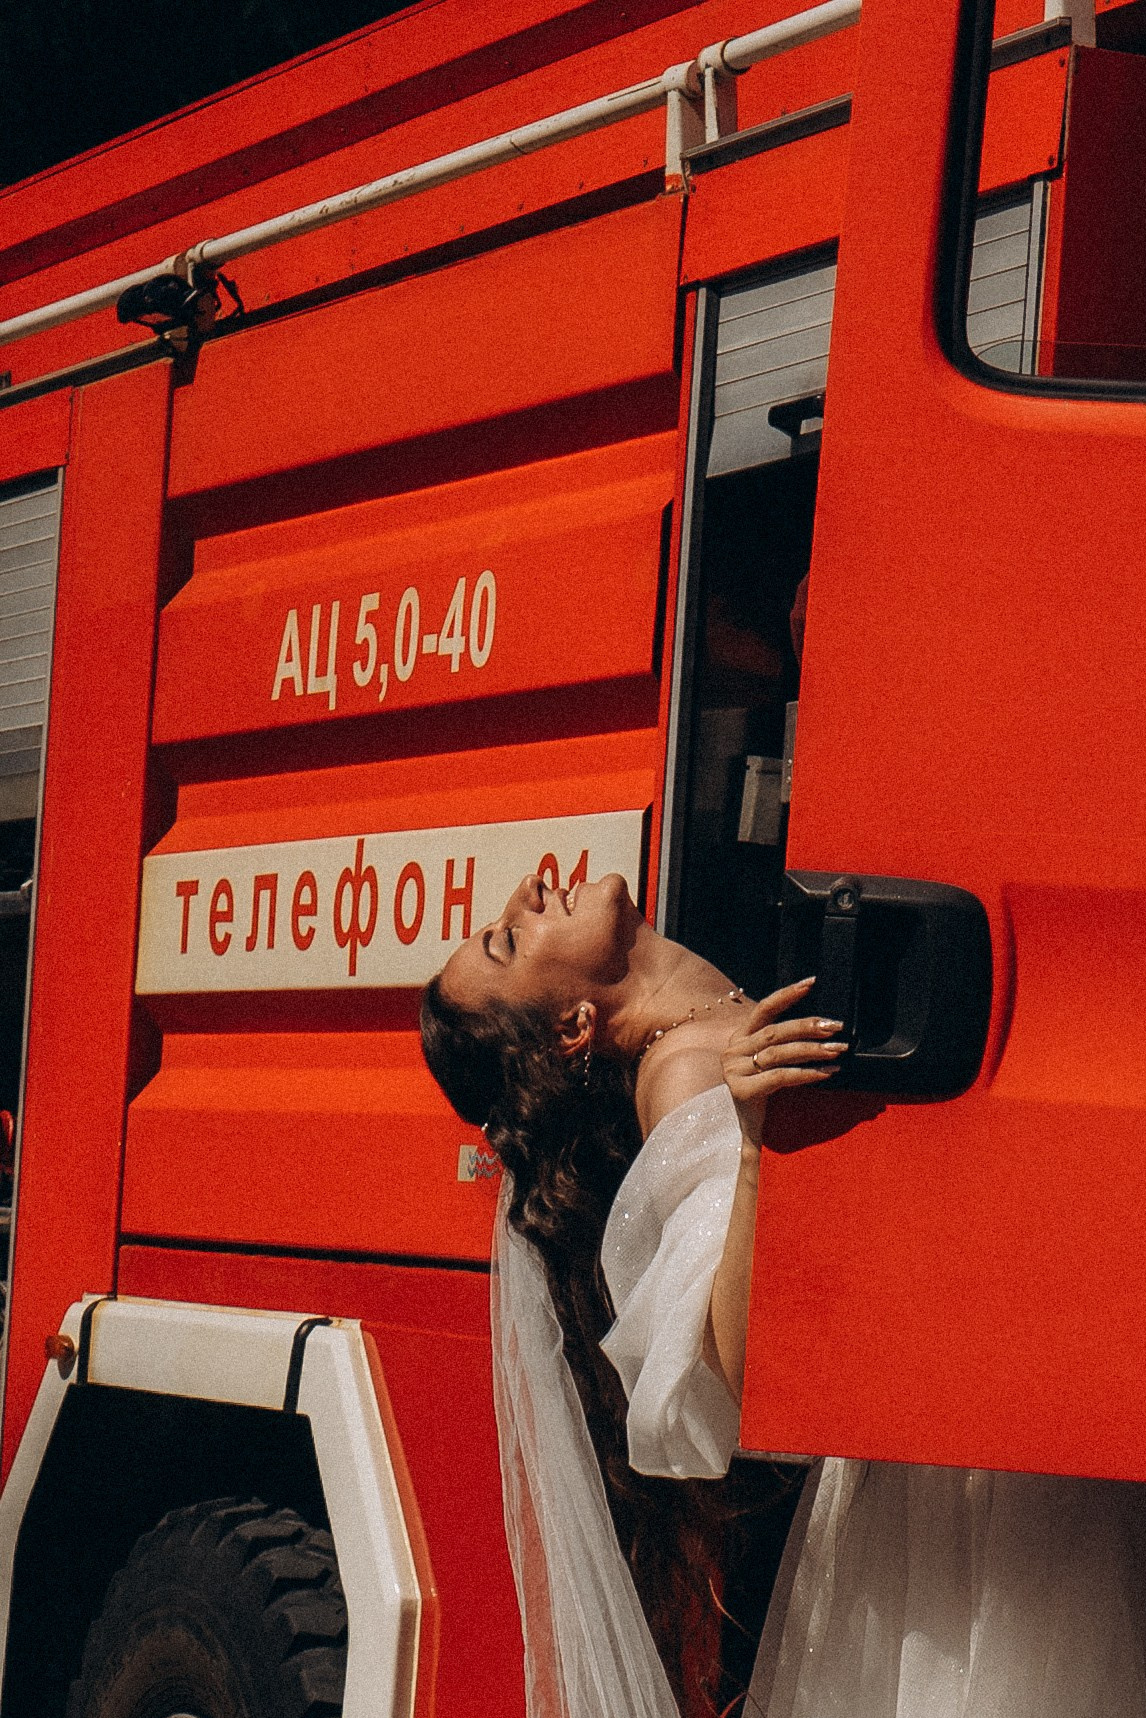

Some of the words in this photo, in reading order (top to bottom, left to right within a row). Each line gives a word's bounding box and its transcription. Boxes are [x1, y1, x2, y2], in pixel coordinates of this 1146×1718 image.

[271, 600, 340, 711] АЦ
[352, 569, 497, 703] 5,0-40
[176, 838, 476, 977] телефон
